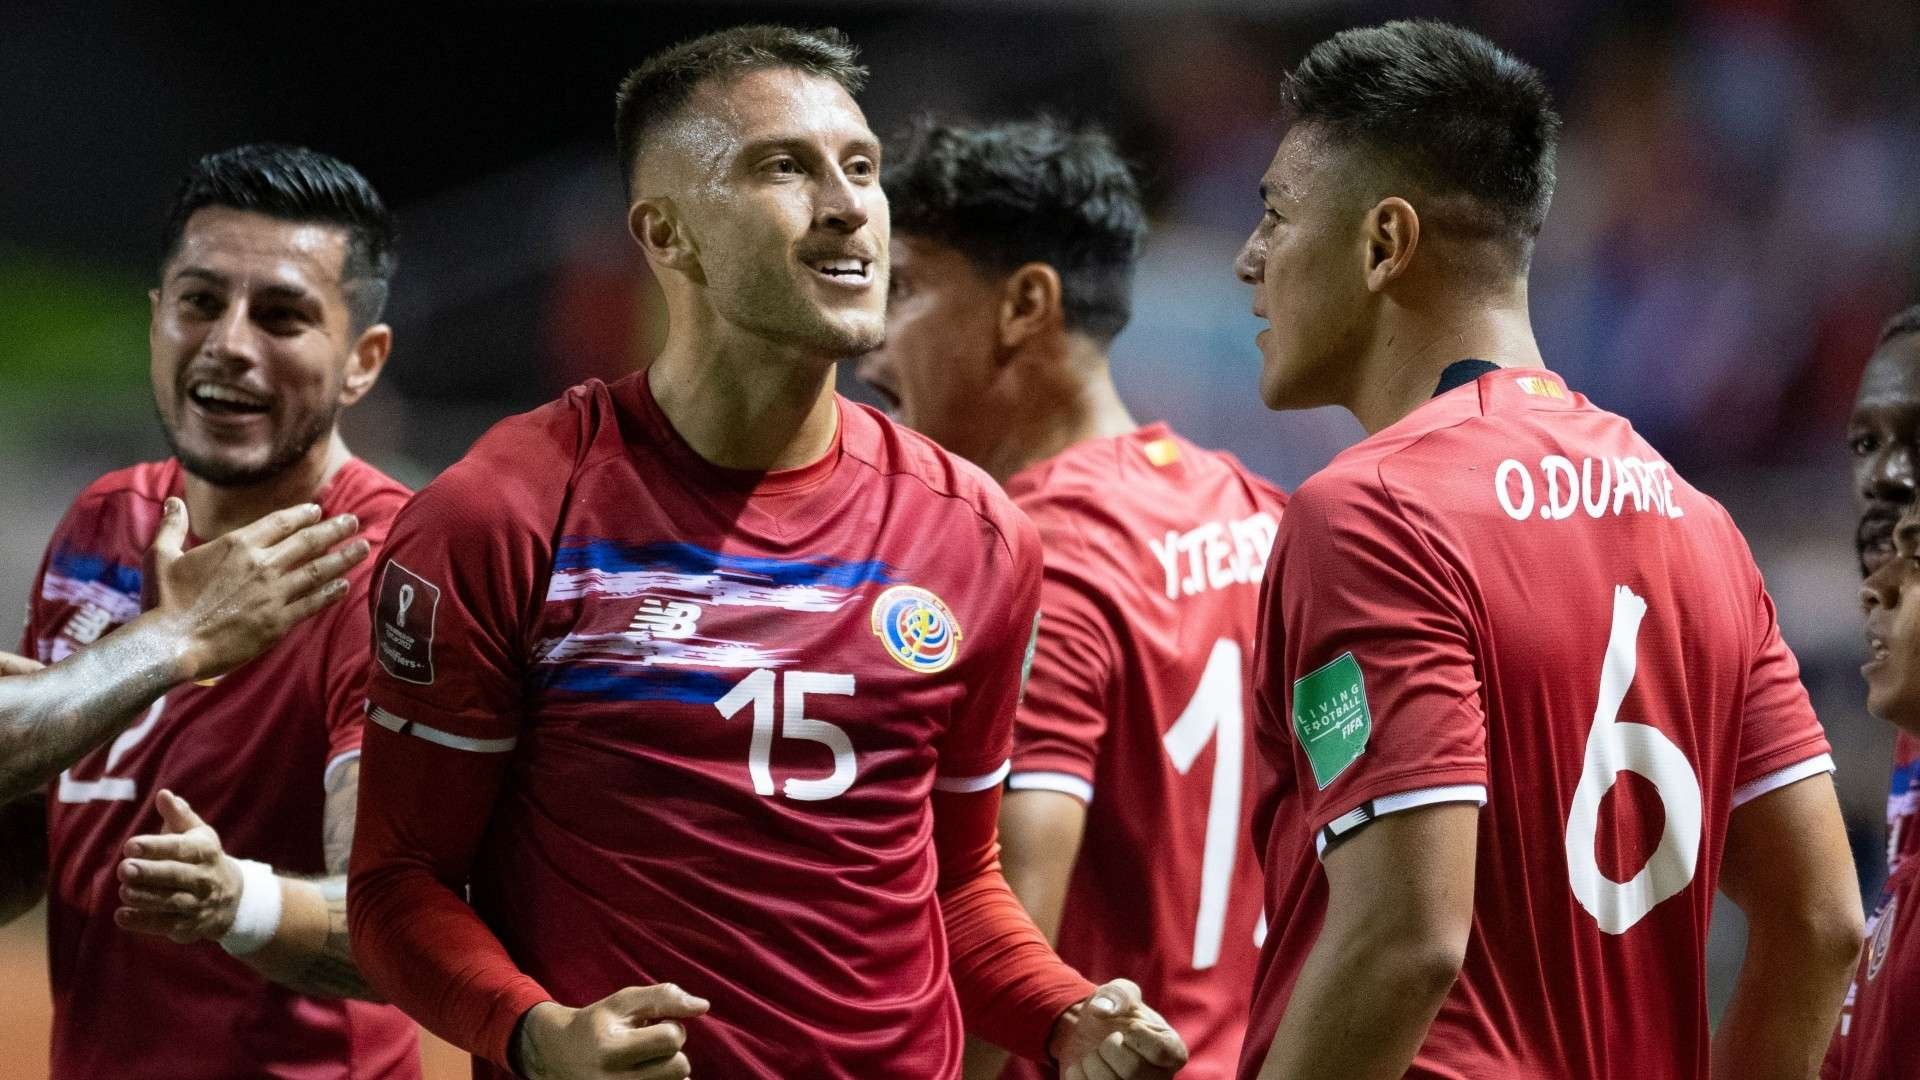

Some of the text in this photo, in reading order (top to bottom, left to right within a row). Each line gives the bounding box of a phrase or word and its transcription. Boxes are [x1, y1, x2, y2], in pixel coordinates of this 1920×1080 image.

[1495, 455, 1684, 521] O.DUARTE
[714, 667, 857, 801] 15
[1297, 683, 1360, 725] LIVING
[1342, 714, 1364, 740] FIFA
[1162, 636, 1268, 970] 1
[1565, 584, 1701, 935] 6
